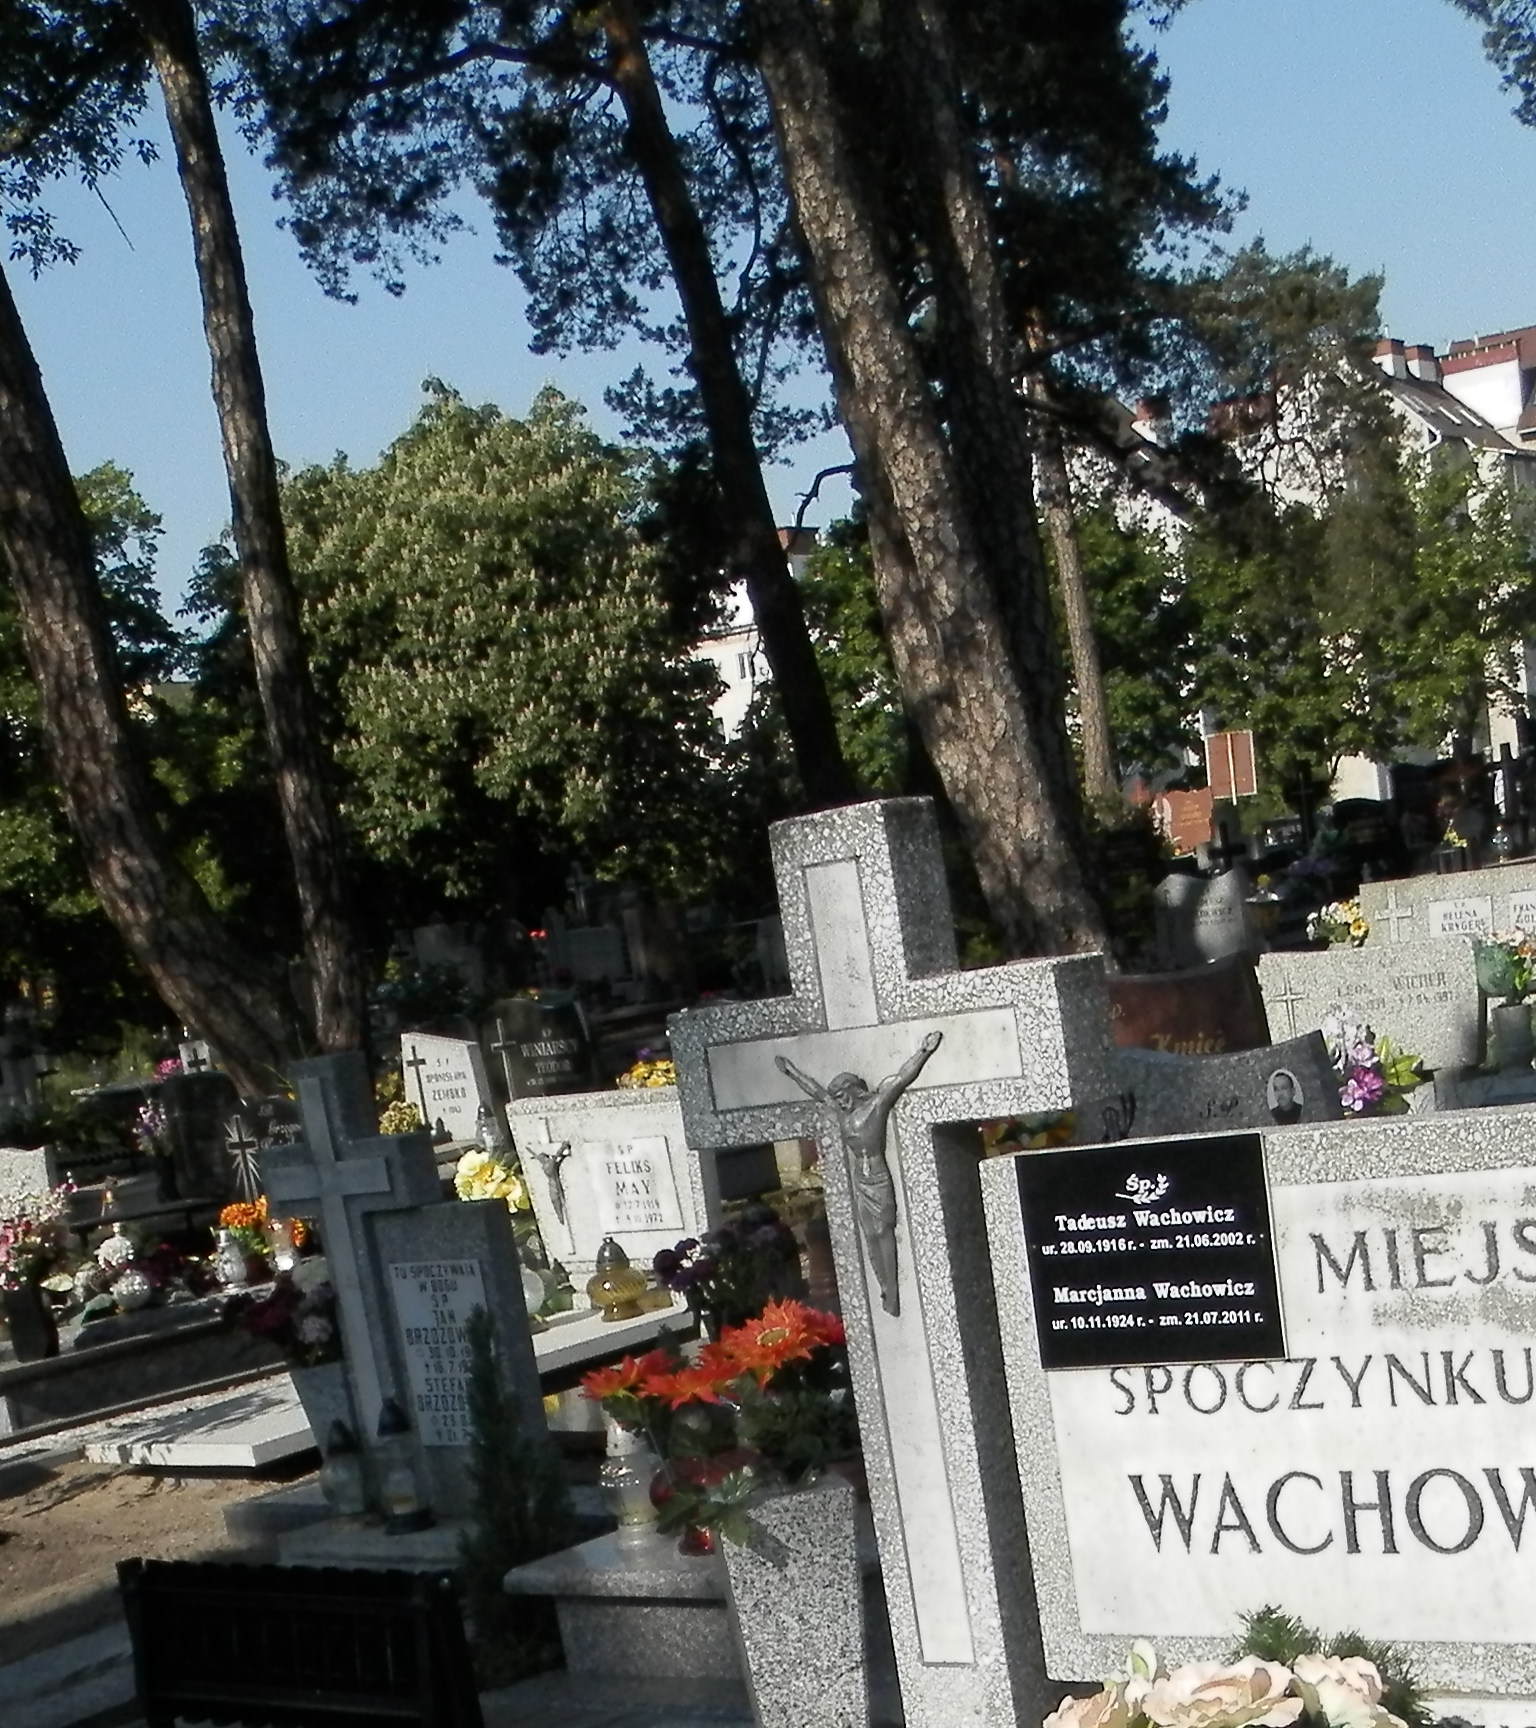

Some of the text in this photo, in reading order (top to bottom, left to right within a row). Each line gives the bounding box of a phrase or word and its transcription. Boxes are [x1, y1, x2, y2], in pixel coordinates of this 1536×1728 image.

[606, 1159, 652, 1174] FELIKS
[615, 1179, 651, 1196] MAY
[1125, 1173, 1156, 1194] Śp.
[1054, 1205, 1235, 1232] Tadeusz Wachowicz
[1041, 1244, 1058, 1256] ur.
[1150, 1238, 1173, 1250] zm.
[1175, 1231, 1244, 1249] 21.06.2002
[1052, 1278, 1256, 1306] Marcjanna Wachowicz
[1051, 1319, 1068, 1330] ur.
[1070, 1313, 1135, 1330] 10.11.1924
[1159, 1315, 1182, 1327] zm.
[1184, 1309, 1251, 1326] 21.07.2011
[1110, 1347, 1535, 1415] SPOCZYNKU
